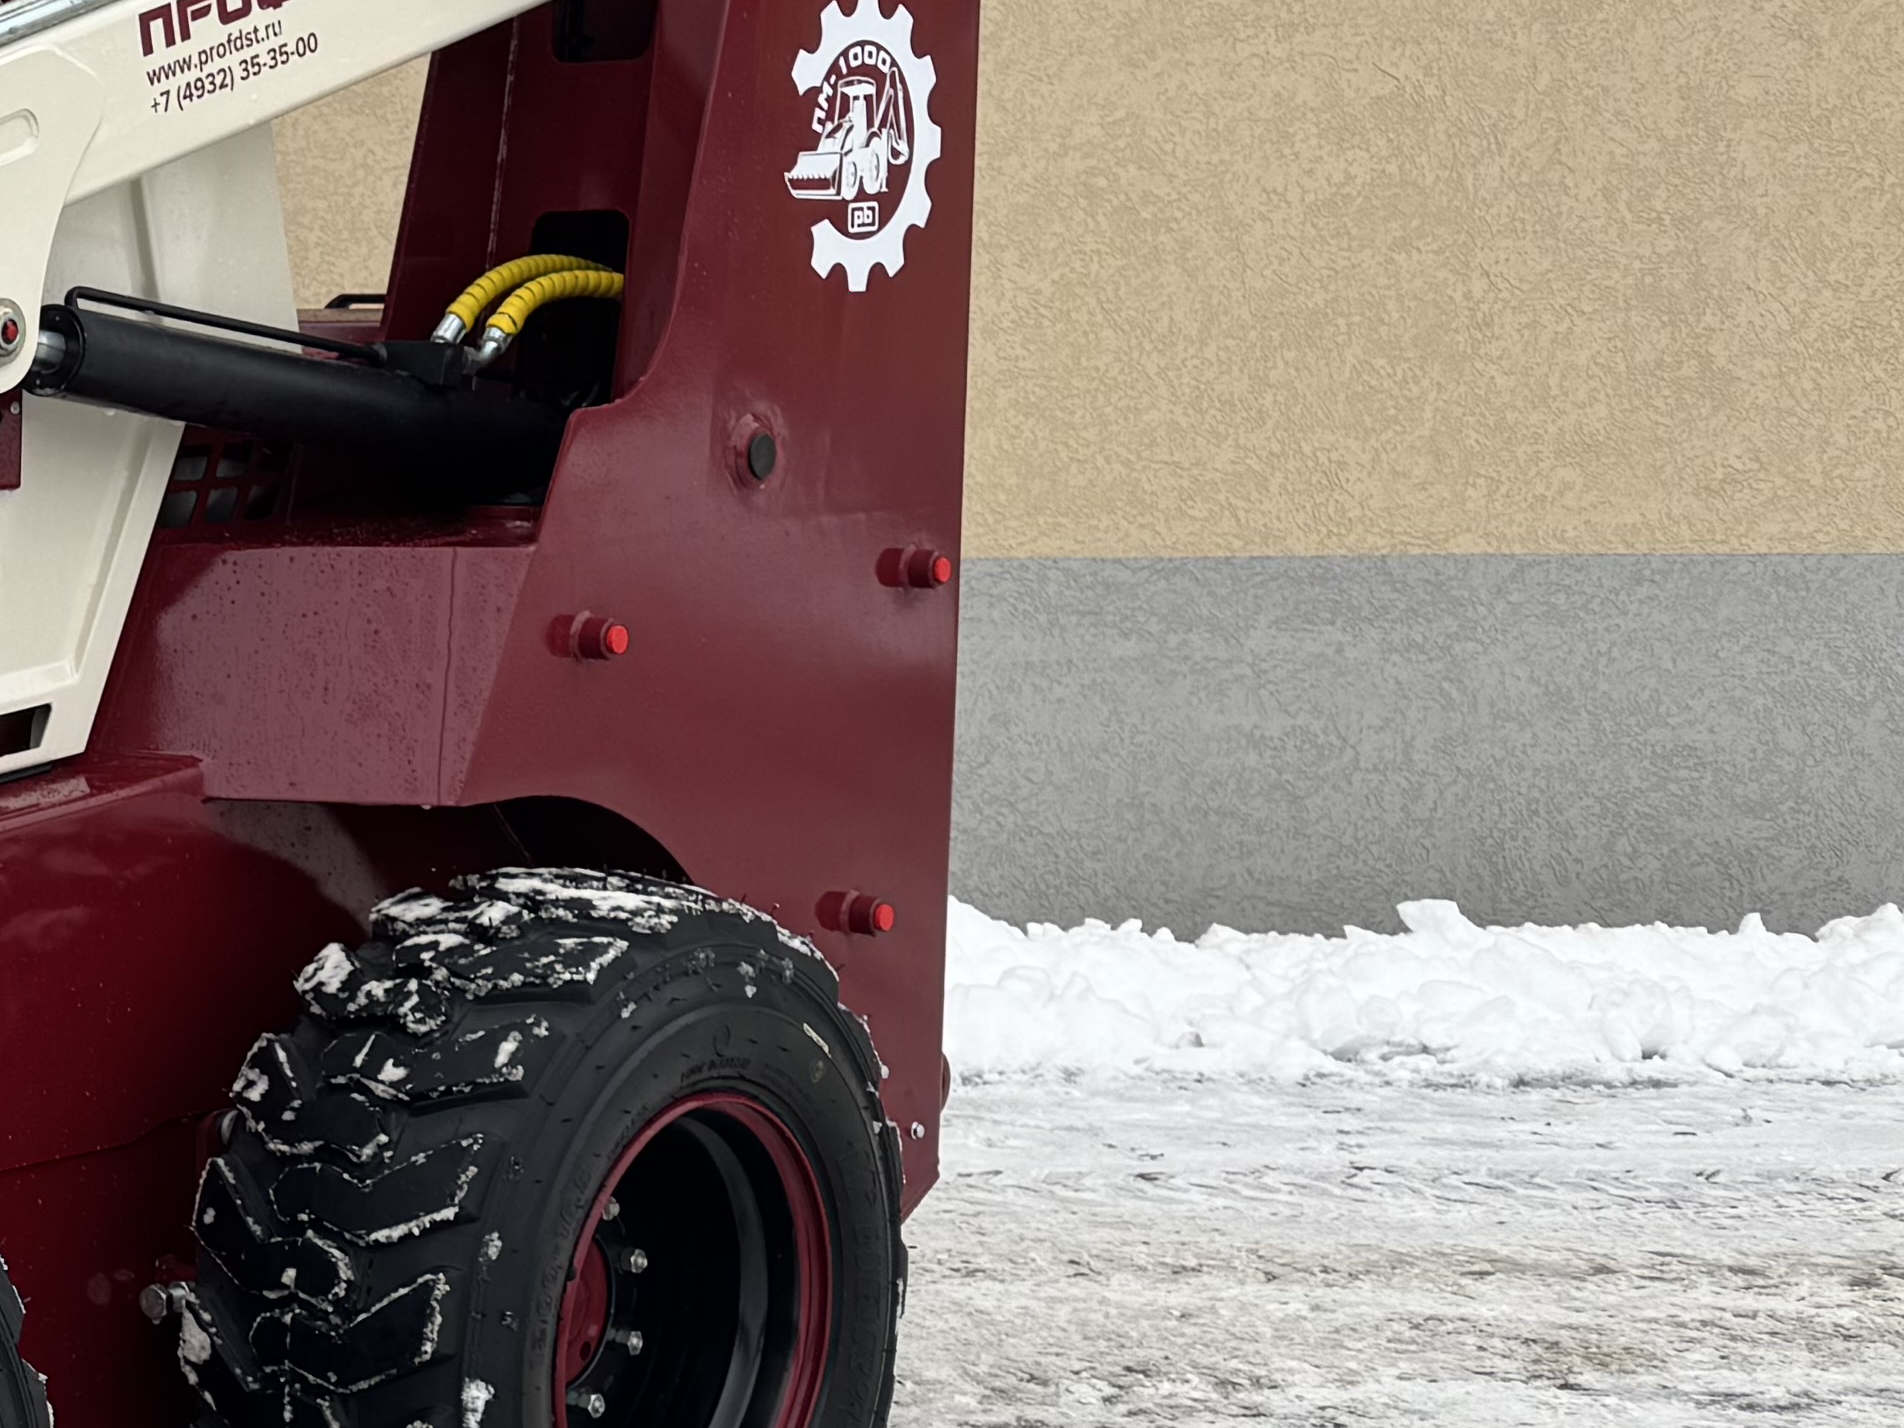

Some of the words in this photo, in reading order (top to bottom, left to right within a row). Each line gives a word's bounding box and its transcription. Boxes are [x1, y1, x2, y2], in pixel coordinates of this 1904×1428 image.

[145, 19, 283, 87] www.profdst.ru
[150, 89, 172, 115] +7
[176, 65, 235, 112] (4932)
[239, 31, 319, 83] 35-35-00
